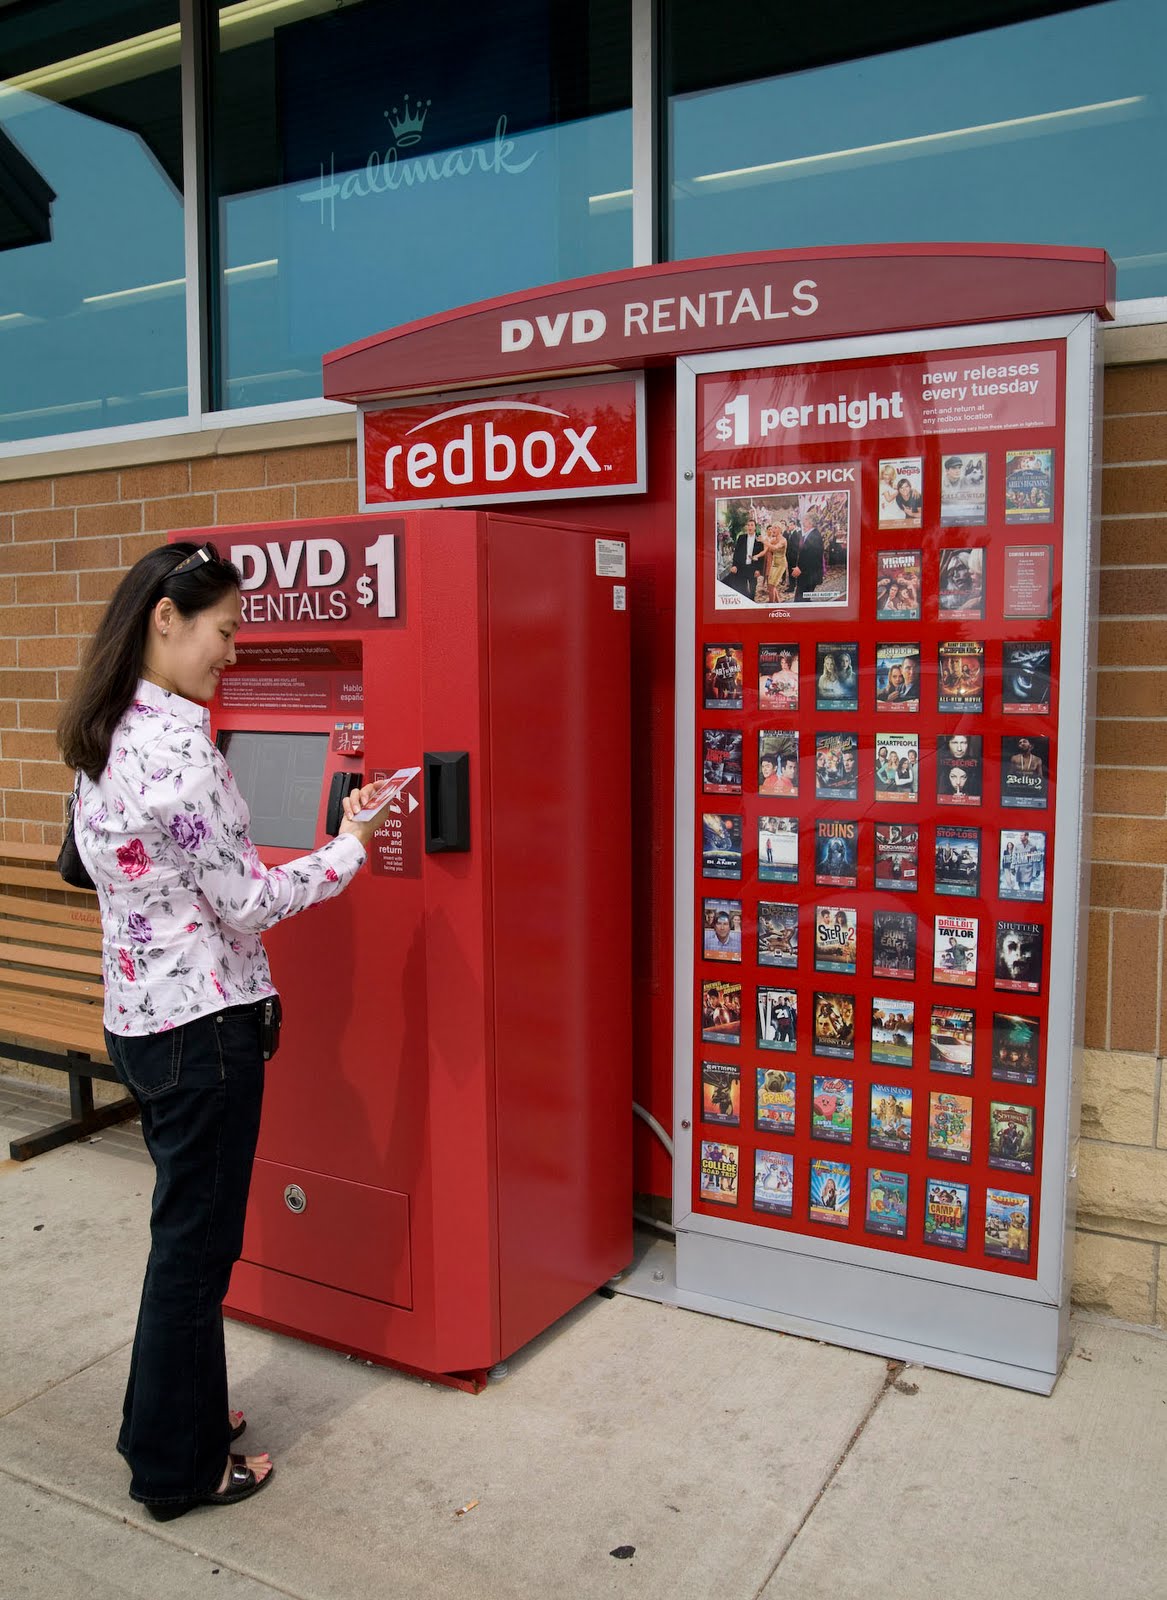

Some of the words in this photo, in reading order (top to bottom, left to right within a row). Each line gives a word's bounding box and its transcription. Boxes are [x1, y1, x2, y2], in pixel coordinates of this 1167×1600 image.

[297, 113, 541, 231] Hallmark
[501, 308, 606, 353] DVD
[624, 279, 819, 337] RENTALS
[922, 371, 957, 385] new
[963, 362, 1040, 381] releases
[922, 386, 967, 401] every
[971, 379, 1039, 397] tuesday
[923, 408, 937, 416] rent
[938, 406, 952, 414] and
[954, 404, 976, 413] return
[715, 394, 749, 446] $1
[760, 403, 813, 437] per
[817, 391, 903, 429] night
[923, 417, 936, 425] any
[937, 414, 962, 423] redbox
[963, 412, 993, 421] location
[384, 421, 602, 490] redbox
[711, 475, 742, 491] THE
[745, 470, 812, 489] REDBOX
[816, 467, 855, 484] PICK
[231, 538, 346, 591] DVD
[882, 555, 915, 566] VIRGIN
[356, 534, 396, 618] $1
[240, 590, 347, 623] RENTALS
[343, 684, 363, 692] Hablo
[340, 692, 364, 702] españo
[384, 819, 402, 828] DVD
[374, 829, 390, 838] pick
[392, 830, 402, 839] up
[818, 822, 854, 839] RUINS
[379, 846, 402, 854] return
[938, 919, 974, 928] DRILLBIT
[998, 921, 1040, 932] SHUTTER
[938, 928, 974, 938] TAYLOR
[774, 1008, 789, 1019] 21
[702, 1158, 737, 1173] COLLEGE
[930, 1203, 954, 1215] CAMP
